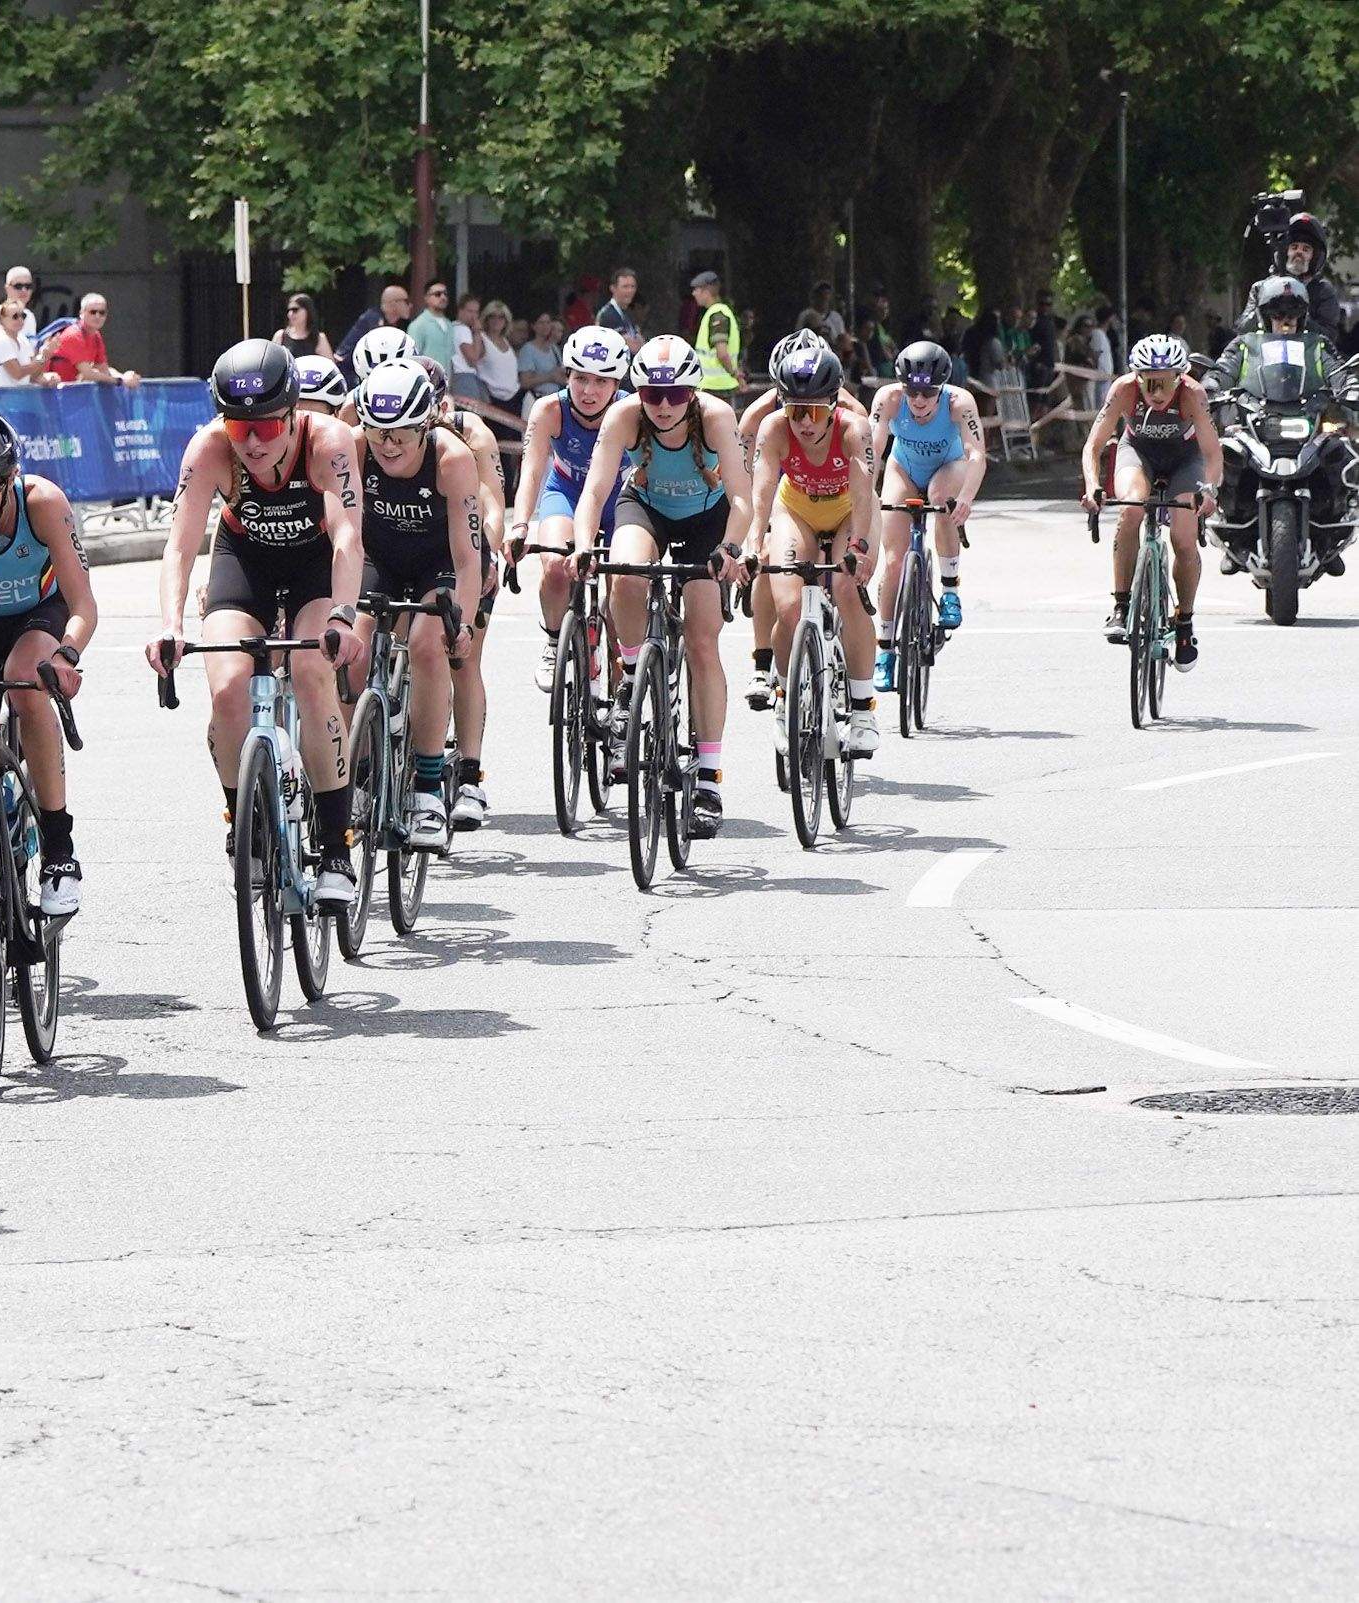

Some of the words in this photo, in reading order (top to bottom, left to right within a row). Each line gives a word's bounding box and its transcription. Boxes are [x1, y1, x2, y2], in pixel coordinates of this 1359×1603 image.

[236, 379, 247, 388] 72
[652, 371, 662, 380] 70
[967, 420, 981, 441] 81
[337, 471, 356, 509] 72
[373, 500, 433, 519] SMITH
[240, 516, 315, 534] KOOTSTRA
[467, 513, 480, 550] 80
[252, 704, 272, 714] BH
[331, 736, 346, 779] 72
